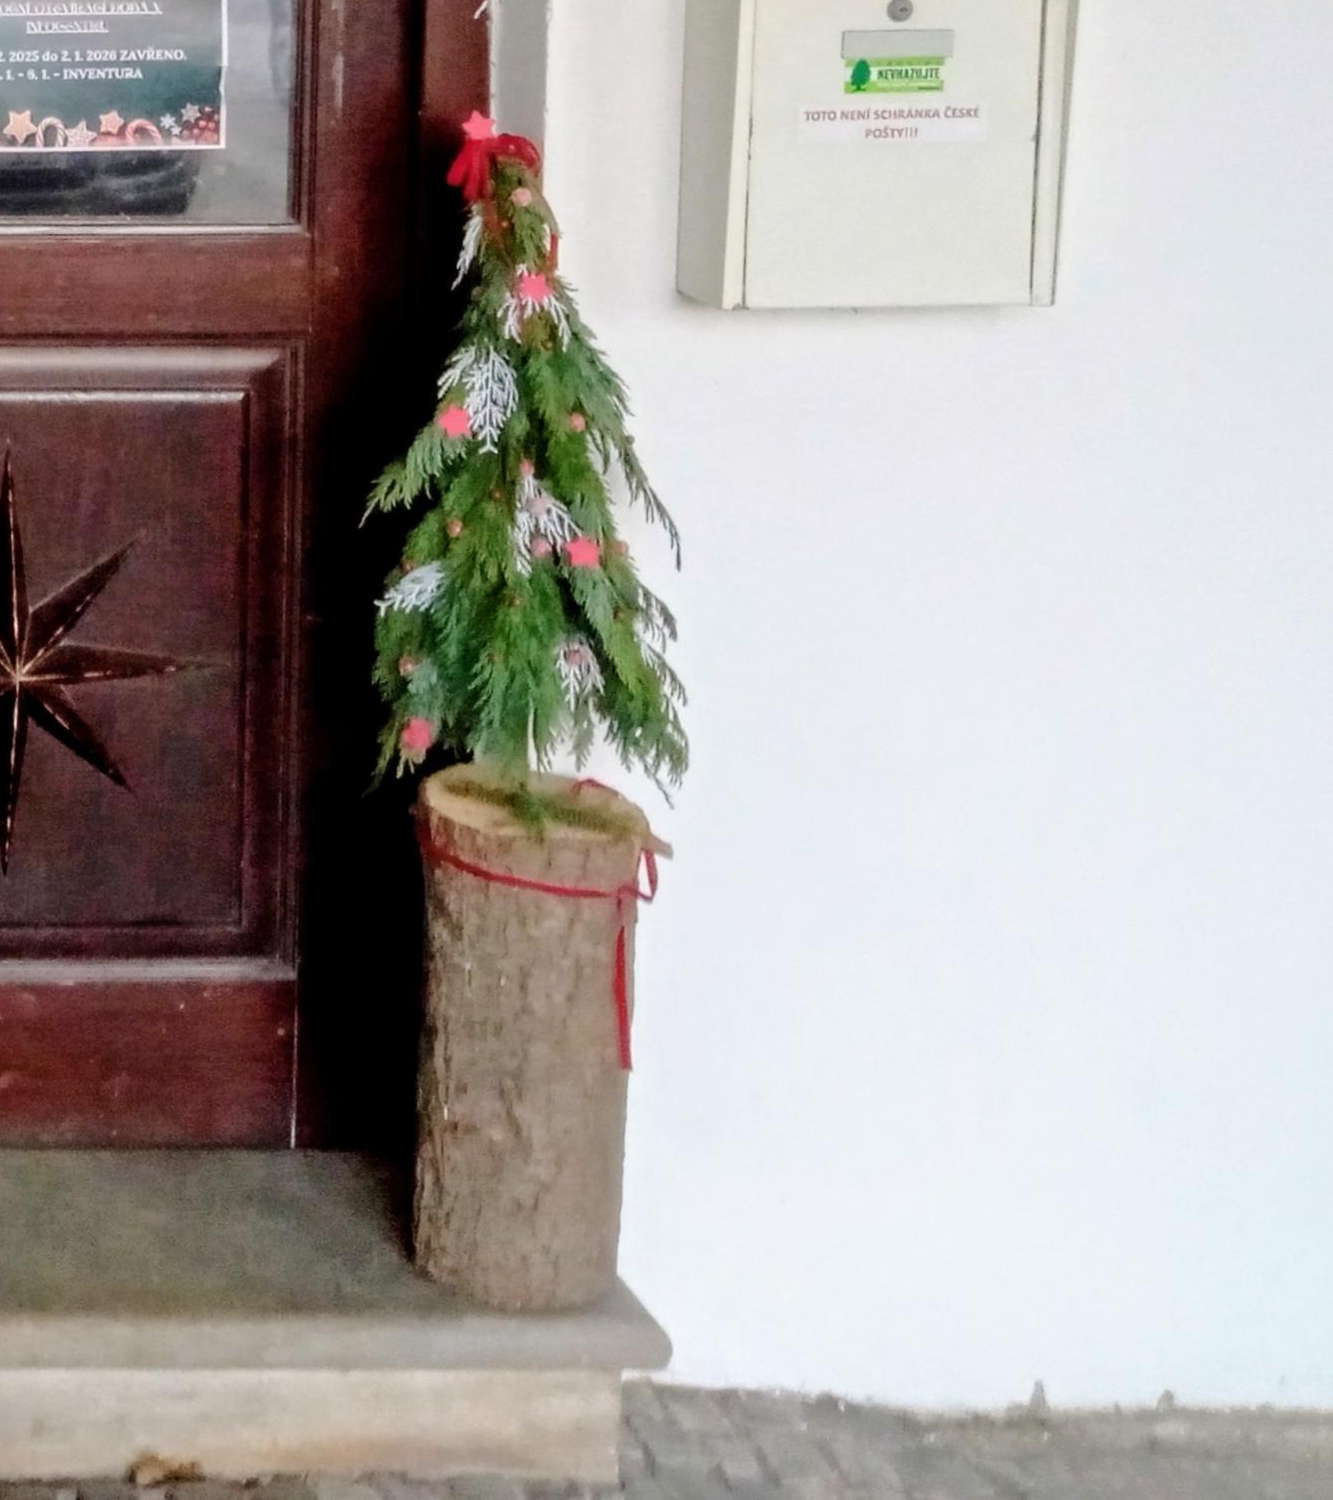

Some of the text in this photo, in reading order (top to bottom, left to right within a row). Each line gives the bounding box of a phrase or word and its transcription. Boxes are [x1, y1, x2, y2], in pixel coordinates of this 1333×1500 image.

[9, 50, 39, 62] 2025
[42, 50, 58, 62] do
[63, 67, 143, 80] INVENTURA
[804, 105, 980, 122] TOTO NENÍ SCHRÁNKA ČESKÉ
[865, 127, 919, 139] POŠTY!!!
